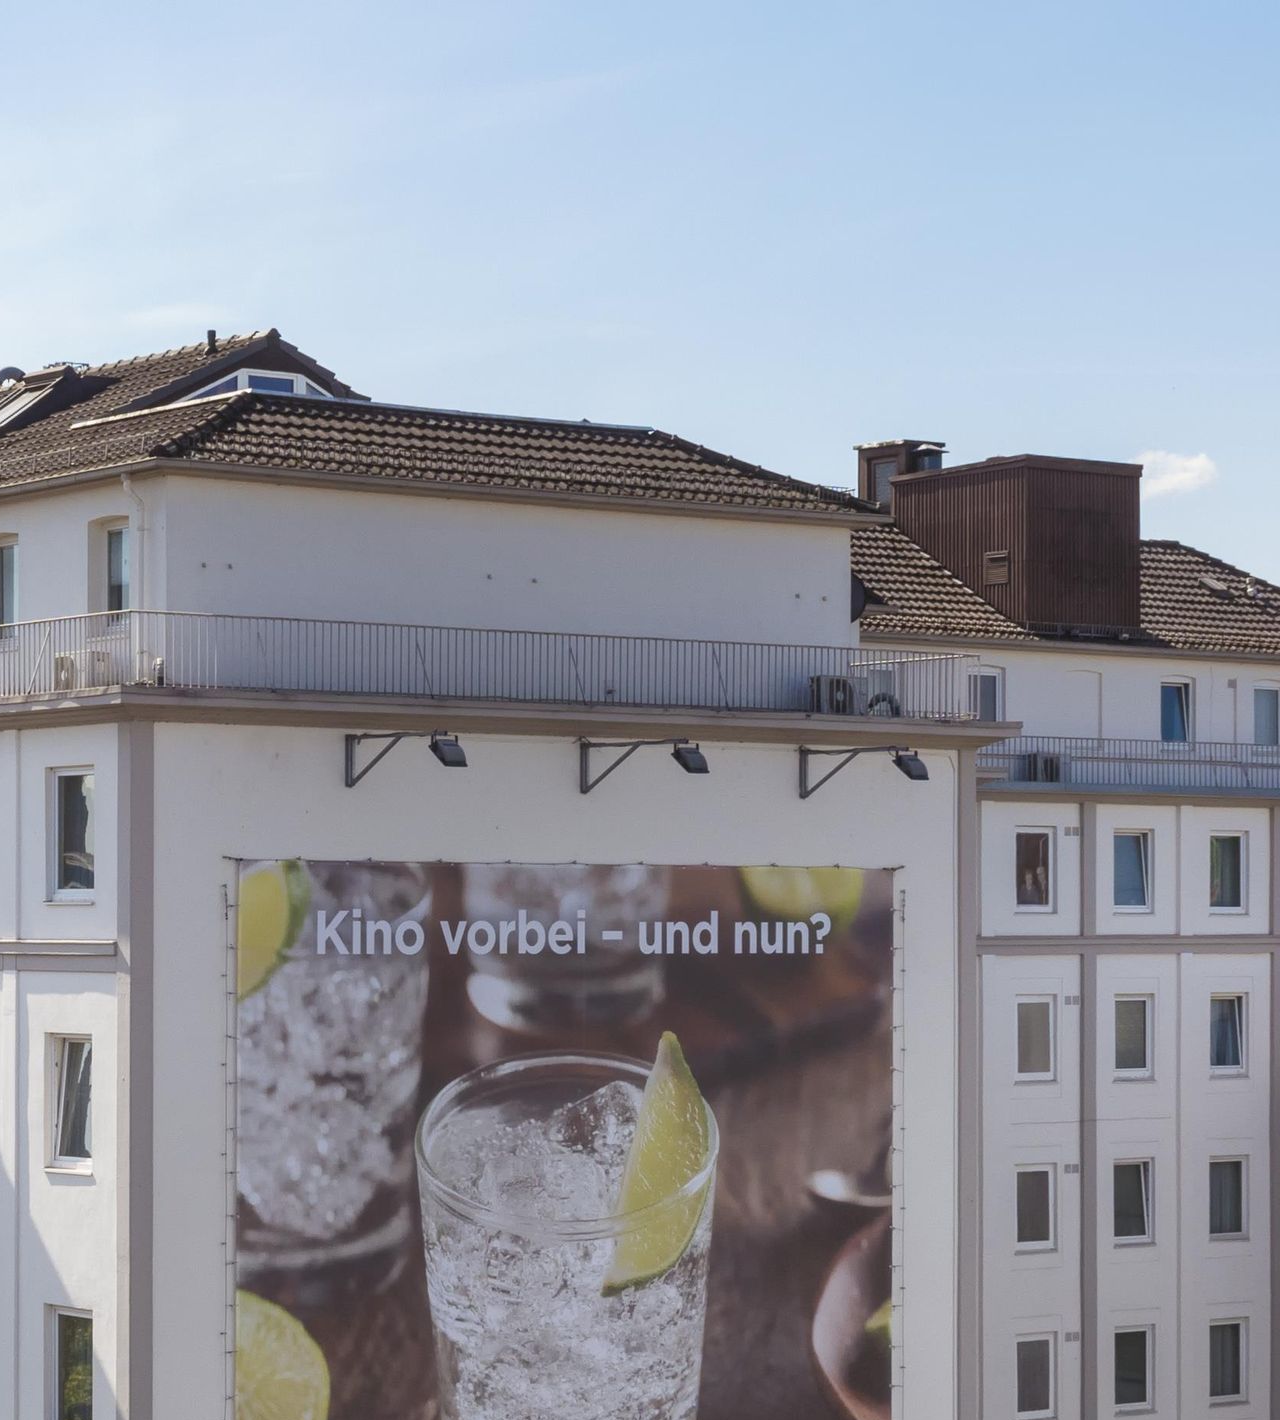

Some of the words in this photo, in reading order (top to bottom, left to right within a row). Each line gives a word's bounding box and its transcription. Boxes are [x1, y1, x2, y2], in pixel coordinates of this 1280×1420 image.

[317, 909, 425, 955] Kino
[440, 909, 587, 955] vorbei
[638, 910, 719, 954] und
[734, 913, 831, 954] nun?
